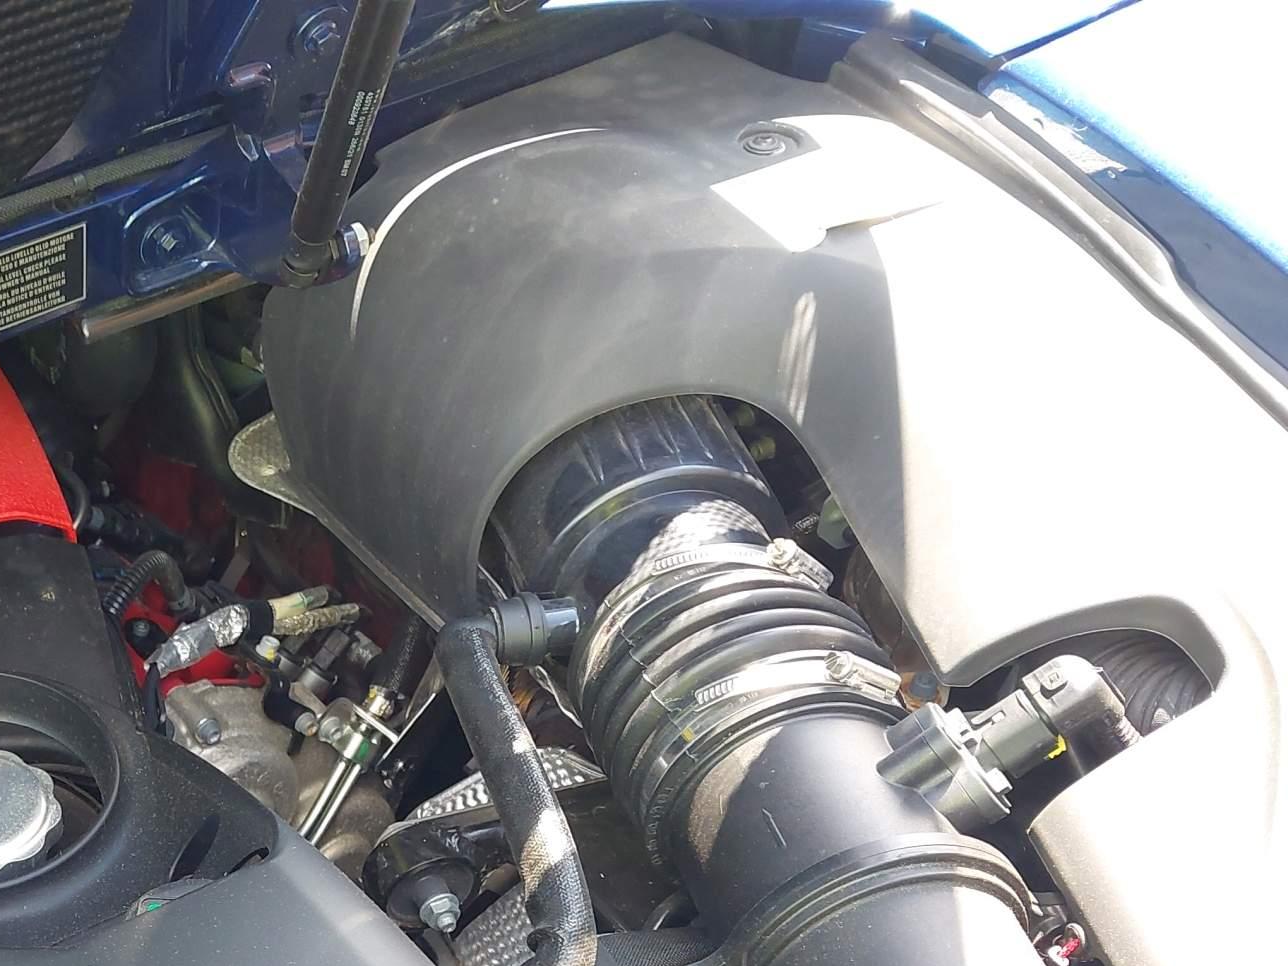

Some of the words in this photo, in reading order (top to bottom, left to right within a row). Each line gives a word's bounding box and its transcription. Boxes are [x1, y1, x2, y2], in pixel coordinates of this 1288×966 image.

[0, 262, 12, 272] USO
[19, 243, 65, 266] MANUTENZIONE
[10, 246, 33, 261] LIVELLO
[35, 241, 48, 252] OLIO
[49, 232, 73, 247] MOTORE
[5, 268, 21, 281] LEVEL
[23, 261, 42, 274] CHECK
[44, 252, 65, 267] PLEASE
[25, 266, 49, 281] MANUAL
[6, 291, 27, 305] NOTICE
[10, 287, 18, 296] DU
[20, 279, 41, 293] NIVEAU
